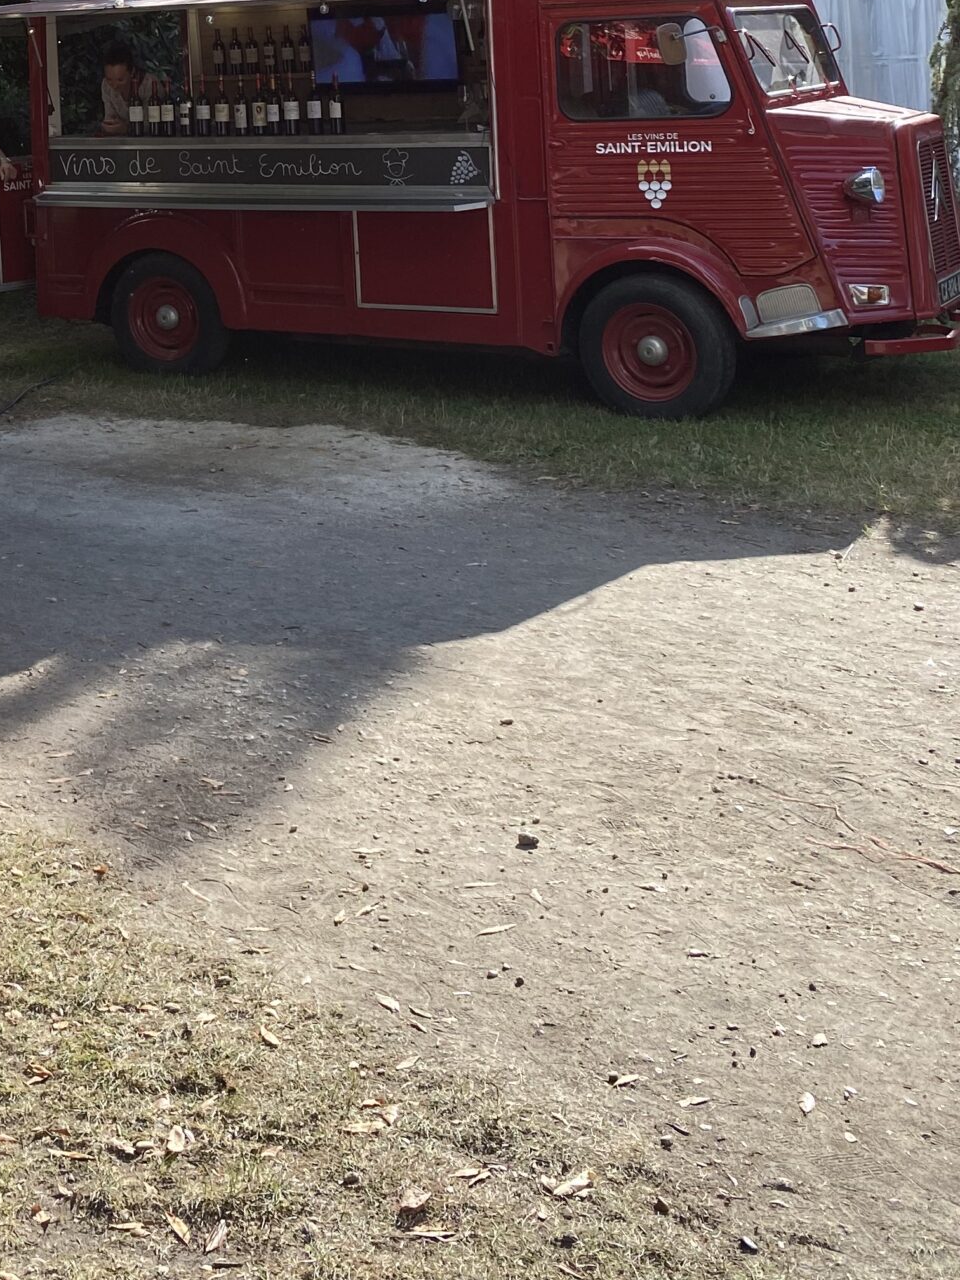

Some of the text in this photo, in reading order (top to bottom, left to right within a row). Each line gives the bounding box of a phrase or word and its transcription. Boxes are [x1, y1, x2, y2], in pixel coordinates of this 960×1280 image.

[627, 133, 643, 141] LES
[666, 132, 679, 140] DE
[595, 141, 713, 154] SAINT-EMILION
[59, 149, 363, 178] Vins de Saint Emilion
